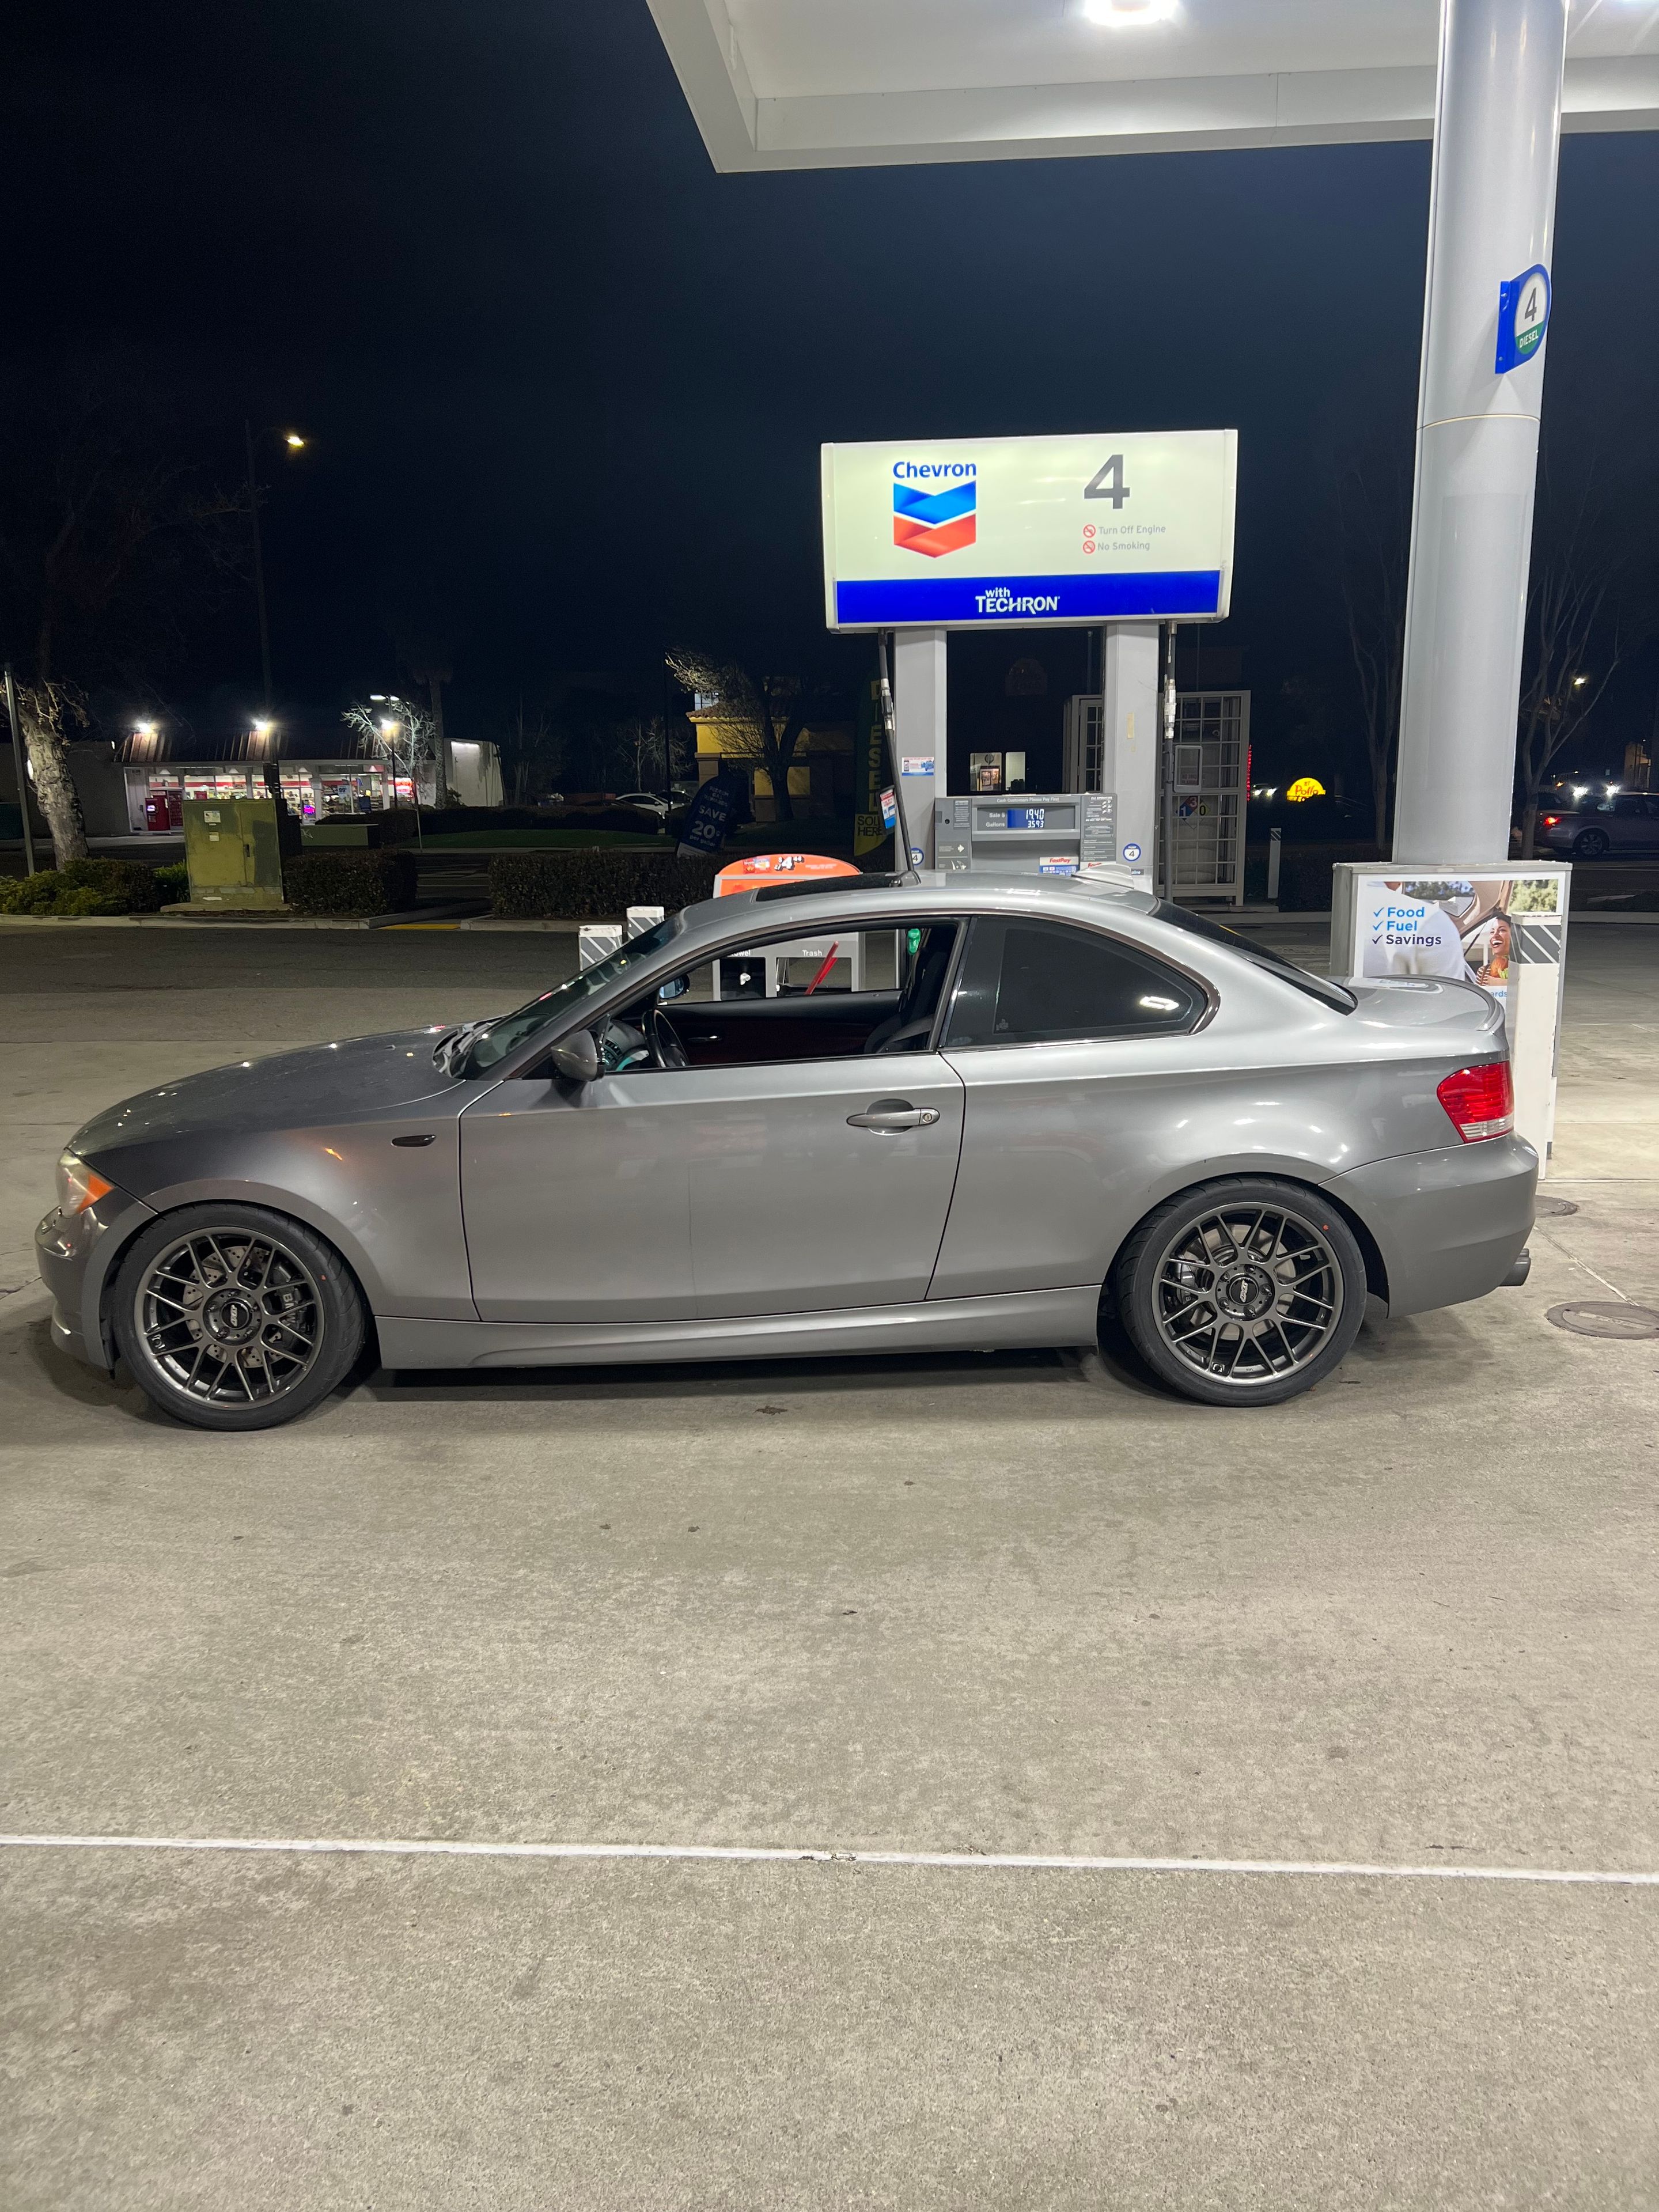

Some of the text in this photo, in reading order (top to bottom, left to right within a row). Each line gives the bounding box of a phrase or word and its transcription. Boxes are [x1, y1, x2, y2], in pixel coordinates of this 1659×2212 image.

[1524, 287, 1537, 322] 4
[1519, 329, 1539, 349] DIESEL
[893, 461, 977, 479] Chevron
[1084, 454, 1130, 510] 4
[1099, 524, 1166, 536] Turn Off Engine
[1097, 540, 1150, 552] No Smoking
[985, 586, 1010, 598] with
[975, 596, 1060, 615] TECHRON
[1190, 797, 1196, 808] 3
[699, 804, 727, 822] SAVE
[1181, 806, 1187, 817] 1
[1199, 805, 1206, 816] 0
[1387, 907, 1425, 918] Food
[1387, 921, 1417, 931] Fuel
[1386, 934, 1442, 947] Savings
